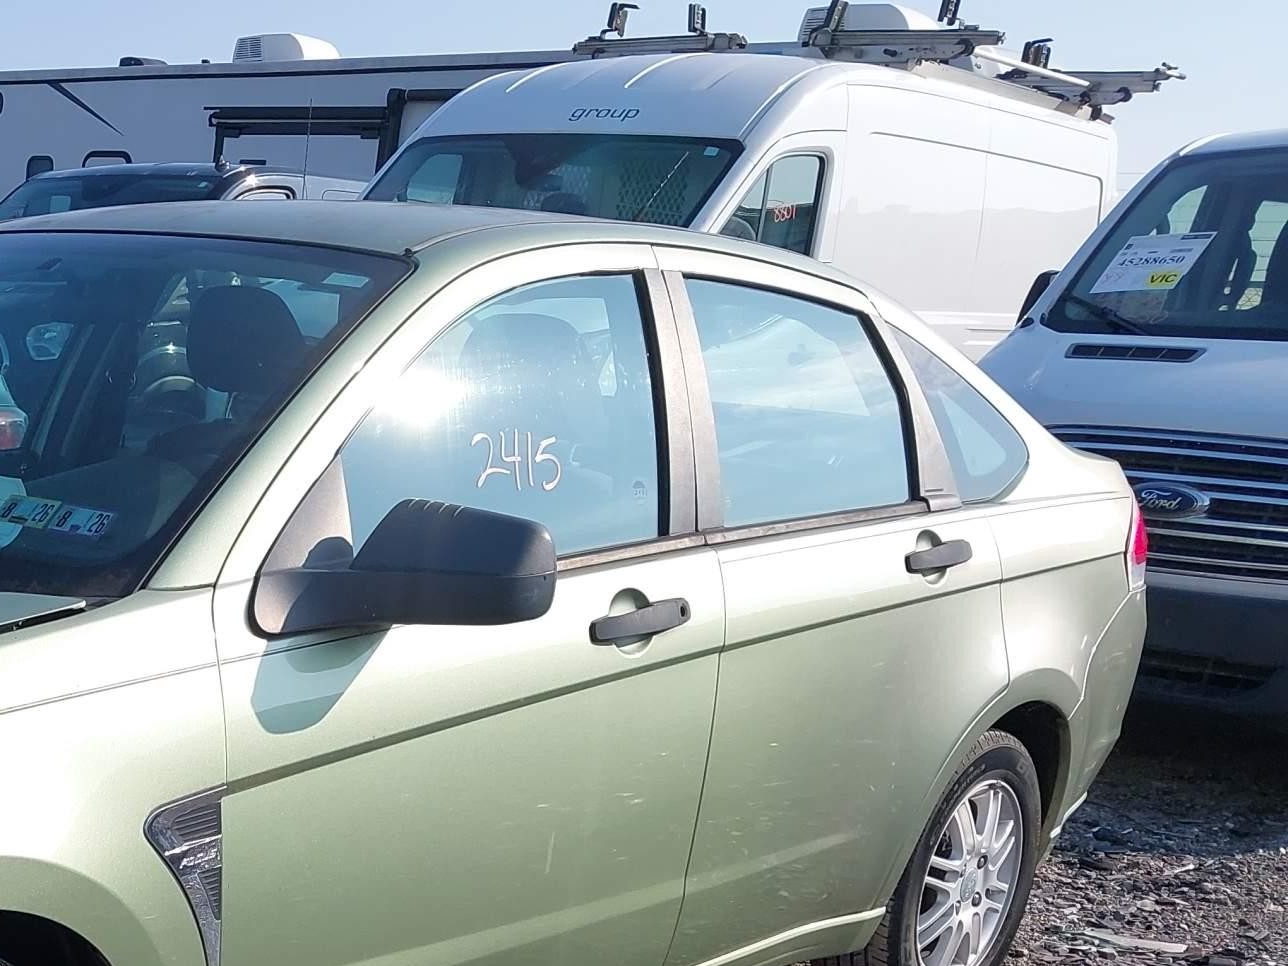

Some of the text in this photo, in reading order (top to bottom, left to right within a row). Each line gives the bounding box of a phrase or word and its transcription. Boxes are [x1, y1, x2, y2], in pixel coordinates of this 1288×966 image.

[568, 107, 640, 122] group
[1149, 273, 1177, 283] VIC
[471, 428, 561, 491] 2415
[1141, 489, 1182, 510] Ford
[0, 502, 56, 523] 8 26
[55, 510, 111, 534] 8 26
